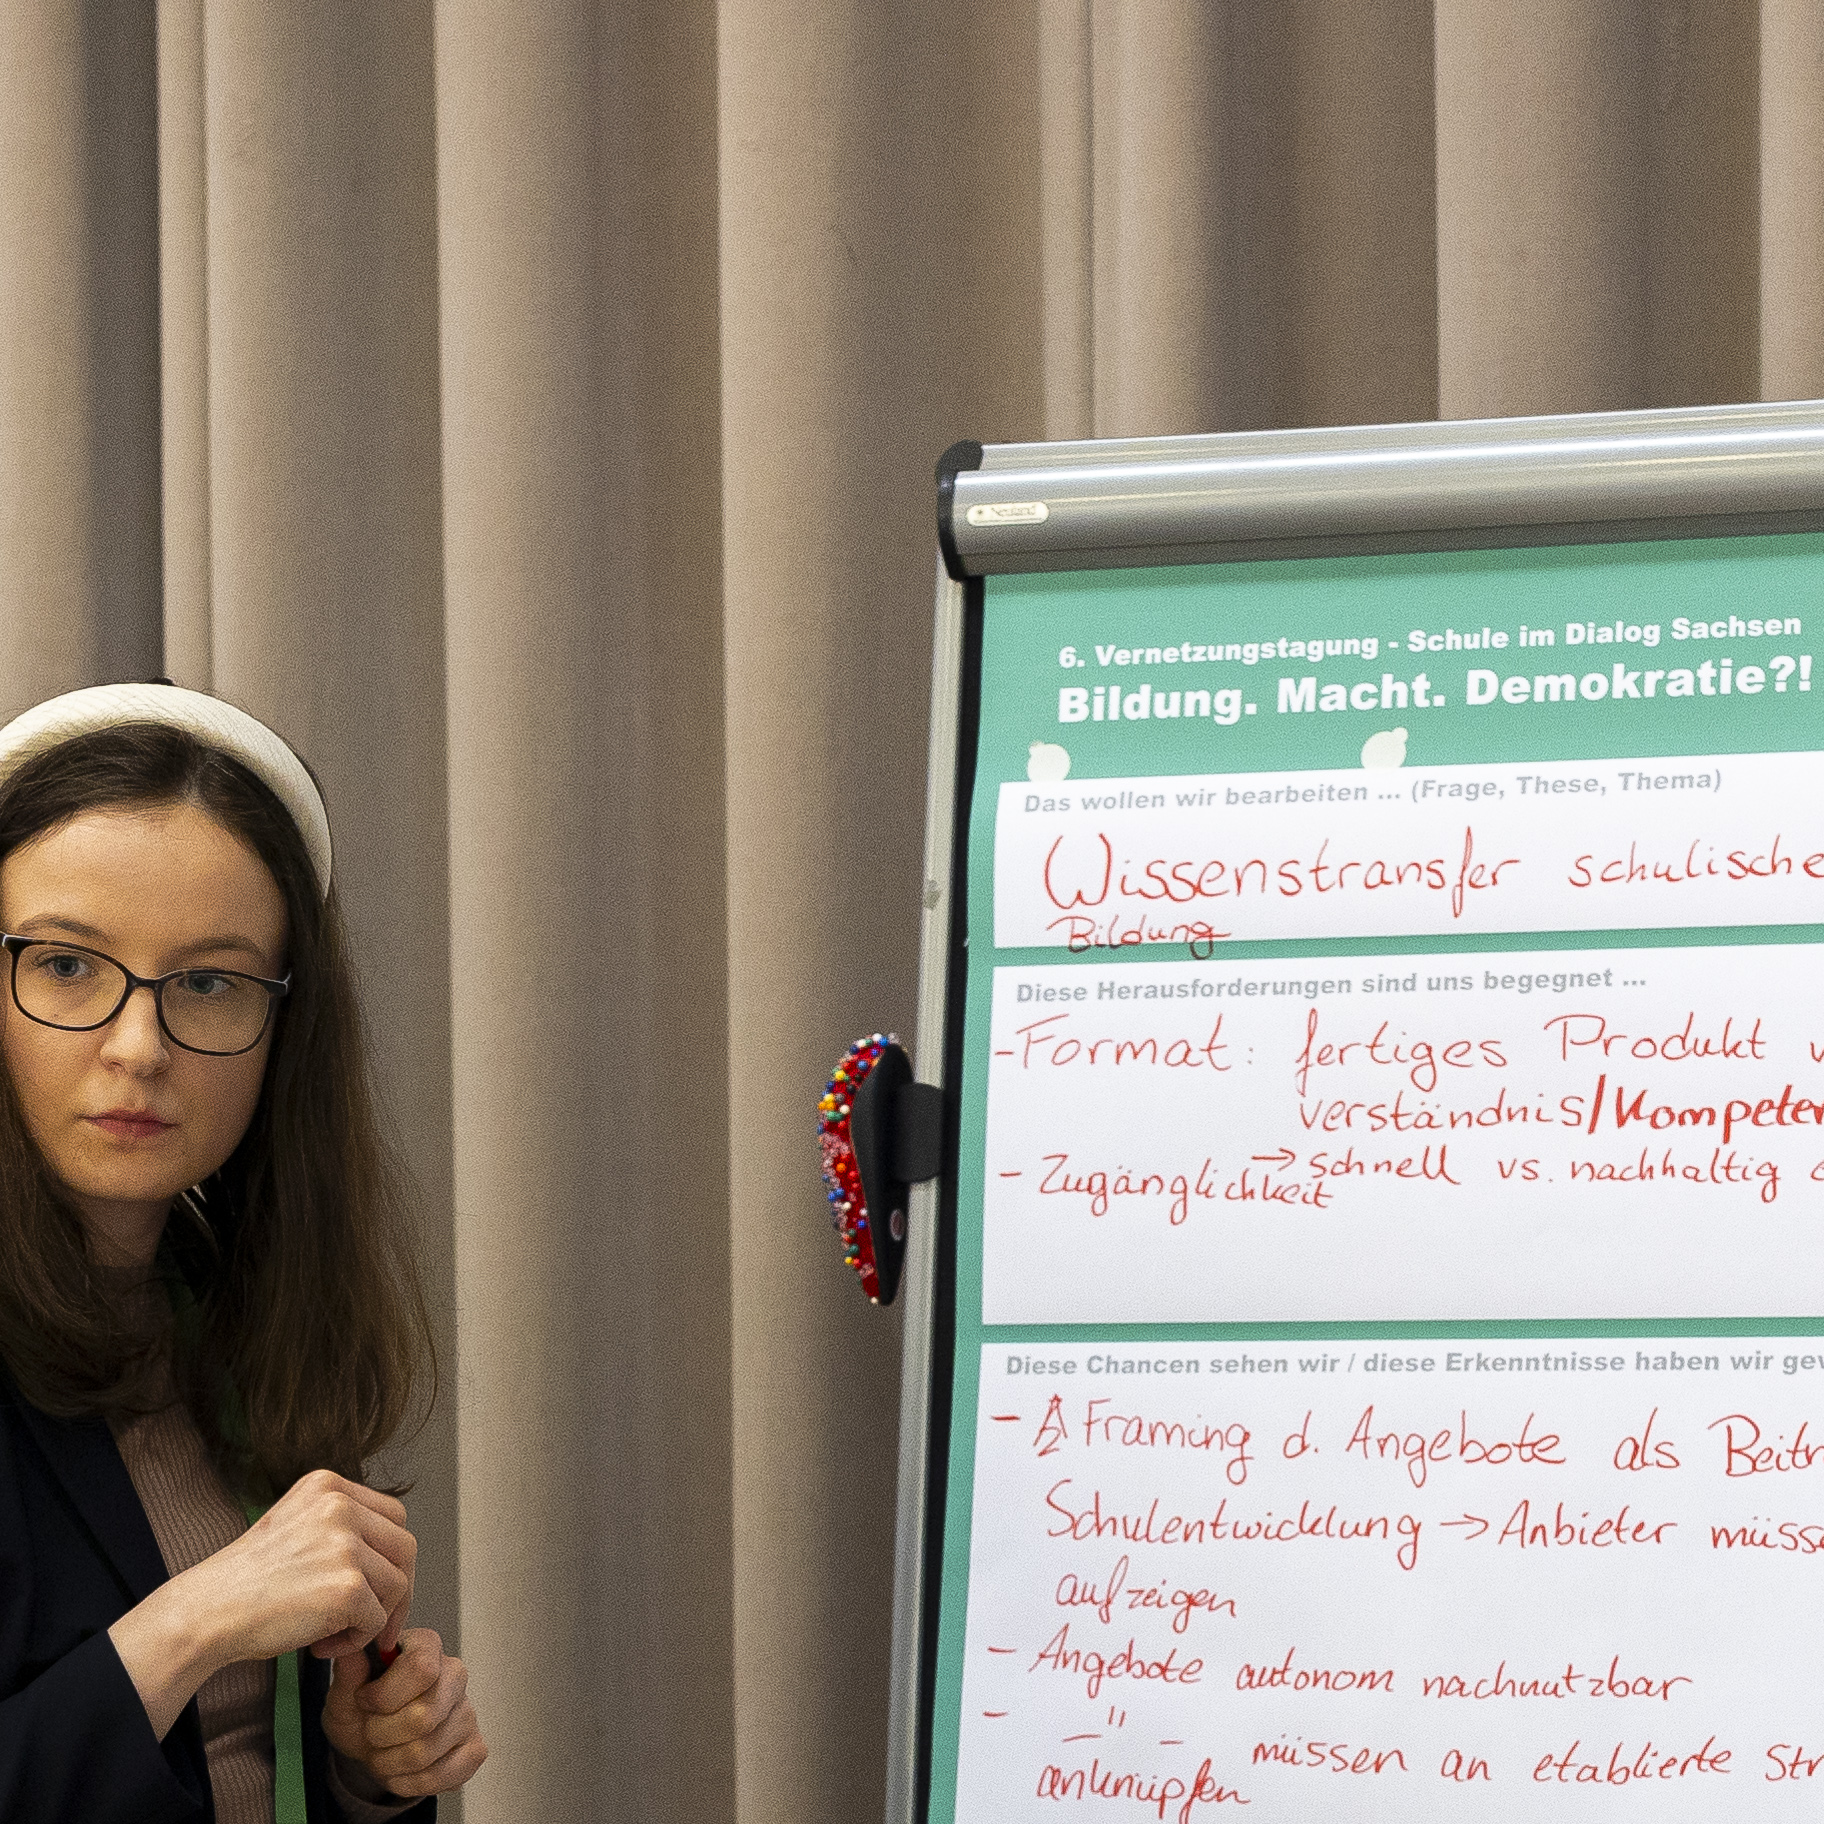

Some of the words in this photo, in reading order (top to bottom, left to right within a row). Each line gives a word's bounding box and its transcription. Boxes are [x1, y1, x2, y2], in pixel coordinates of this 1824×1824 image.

[1059, 646, 1085, 668] 6.
[1095, 636, 1378, 667] Vernetzungstagung
[1407, 627, 1509, 653] Schule
[1519, 626, 1555, 647] im
[1566, 621, 1661, 646] Dialog
[1671, 615, 1801, 640] Sachsen
[1058, 684, 1257, 725] Bildung.
[1278, 672, 1446, 714] Macht.
[1466, 655, 1812, 705] Demokratie?!
[1024, 795, 1071, 814] Das
[1081, 791, 1166, 810] wollen
[1176, 789, 1217, 807] wir
[1225, 784, 1368, 805] bearbeiten
[1411, 779, 1505, 803] (Frage,
[1516, 774, 1608, 797] These,
[1617, 769, 1722, 792] Thema)
[1044, 826, 1520, 918] Wissenstransfer
[1045, 914, 1232, 960] Bildung
[1017, 983, 1087, 1003] Diese
[1097, 977, 1353, 1003] Herausforderungen
[1361, 973, 1418, 993] sind
[1427, 975, 1473, 992] uns
[1484, 969, 1613, 994] begegnet
[1296, 1008, 1507, 1096] fertiges
[1544, 1011, 1766, 1062] Produkt
[1039, 1153, 1335, 1225] Zugänglichkeit
[1498, 1157, 1554, 1183] vs.
[1571, 1148, 1781, 1203] nachhaltig
[1006, 1356, 1077, 1375] Diese
[1086, 1355, 1200, 1374] Chancen
[1209, 1354, 1289, 1373] sehen
[1298, 1354, 1341, 1372] wir
[1346, 1353, 1355, 1373] /
[1363, 1354, 1435, 1373] diese
[1446, 1352, 1625, 1372] Erkenntnisse
[1635, 1352, 1719, 1371] haben
[1730, 1351, 1774, 1370] wir
[1083, 1399, 1254, 1485] Framing
[1283, 1410, 1319, 1460] d.
[1346, 1404, 1566, 1488] Angebote
[1613, 1407, 1680, 1471] als
[1046, 1479, 1422, 1570] Schulentwicklung
[1499, 1499, 1678, 1549] Anbieter
[1056, 1554, 1237, 1634] aufzeigen
[1029, 1623, 1204, 1698] Angebote
[1236, 1646, 1395, 1693] autonom
[1423, 1655, 1693, 1700] nachnutzbar
[1252, 1734, 1409, 1774] müssen
[1440, 1746, 1491, 1782] an
[1533, 1735, 1732, 1785] etablierte
